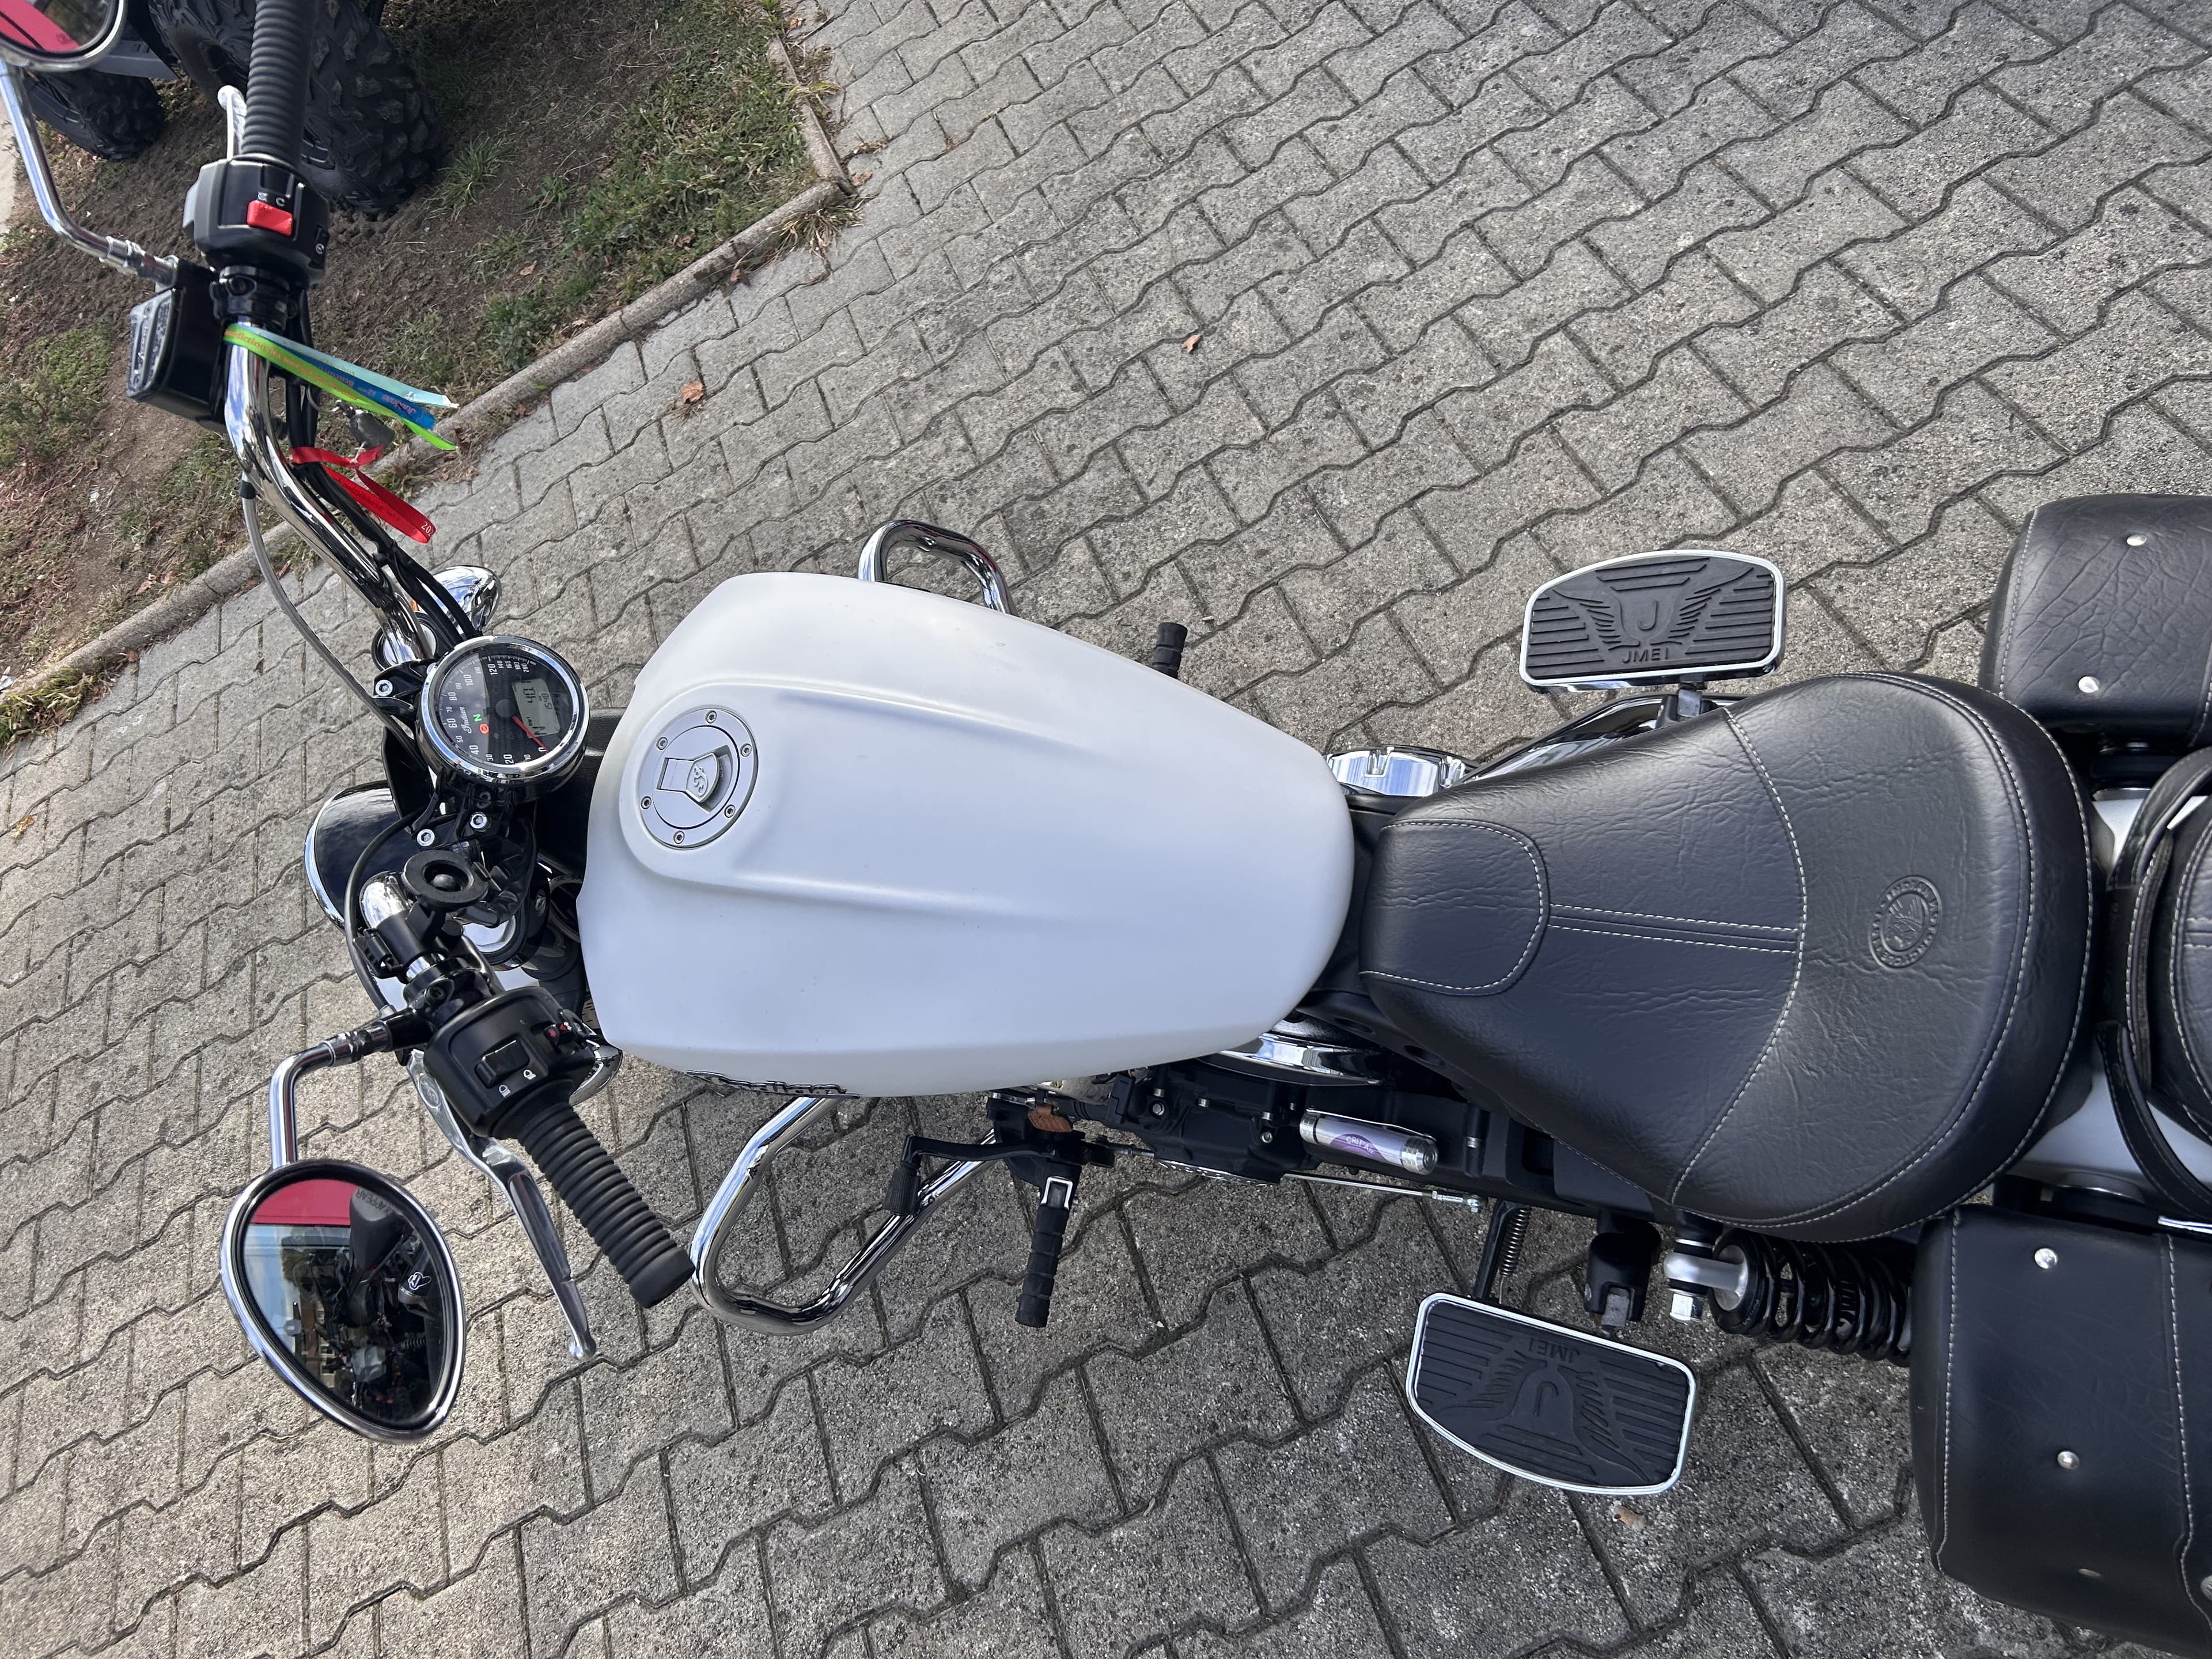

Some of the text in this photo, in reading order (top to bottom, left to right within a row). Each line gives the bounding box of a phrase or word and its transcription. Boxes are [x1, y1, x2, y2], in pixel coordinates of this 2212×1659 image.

[1621, 647, 1669, 664] JMEI
[487, 664, 498, 675] 120
[463, 674, 474, 685] 100
[448, 692, 457, 700] 80
[446, 718, 457, 728] 60
[459, 706, 472, 733] Indian
[473, 714, 482, 722] N
[456, 735, 463, 743] 50
[469, 745, 479, 755] 40
[486, 753, 494, 762] 30
[503, 754, 514, 764] 20
[1527, 1336, 1581, 1363] JMEI
